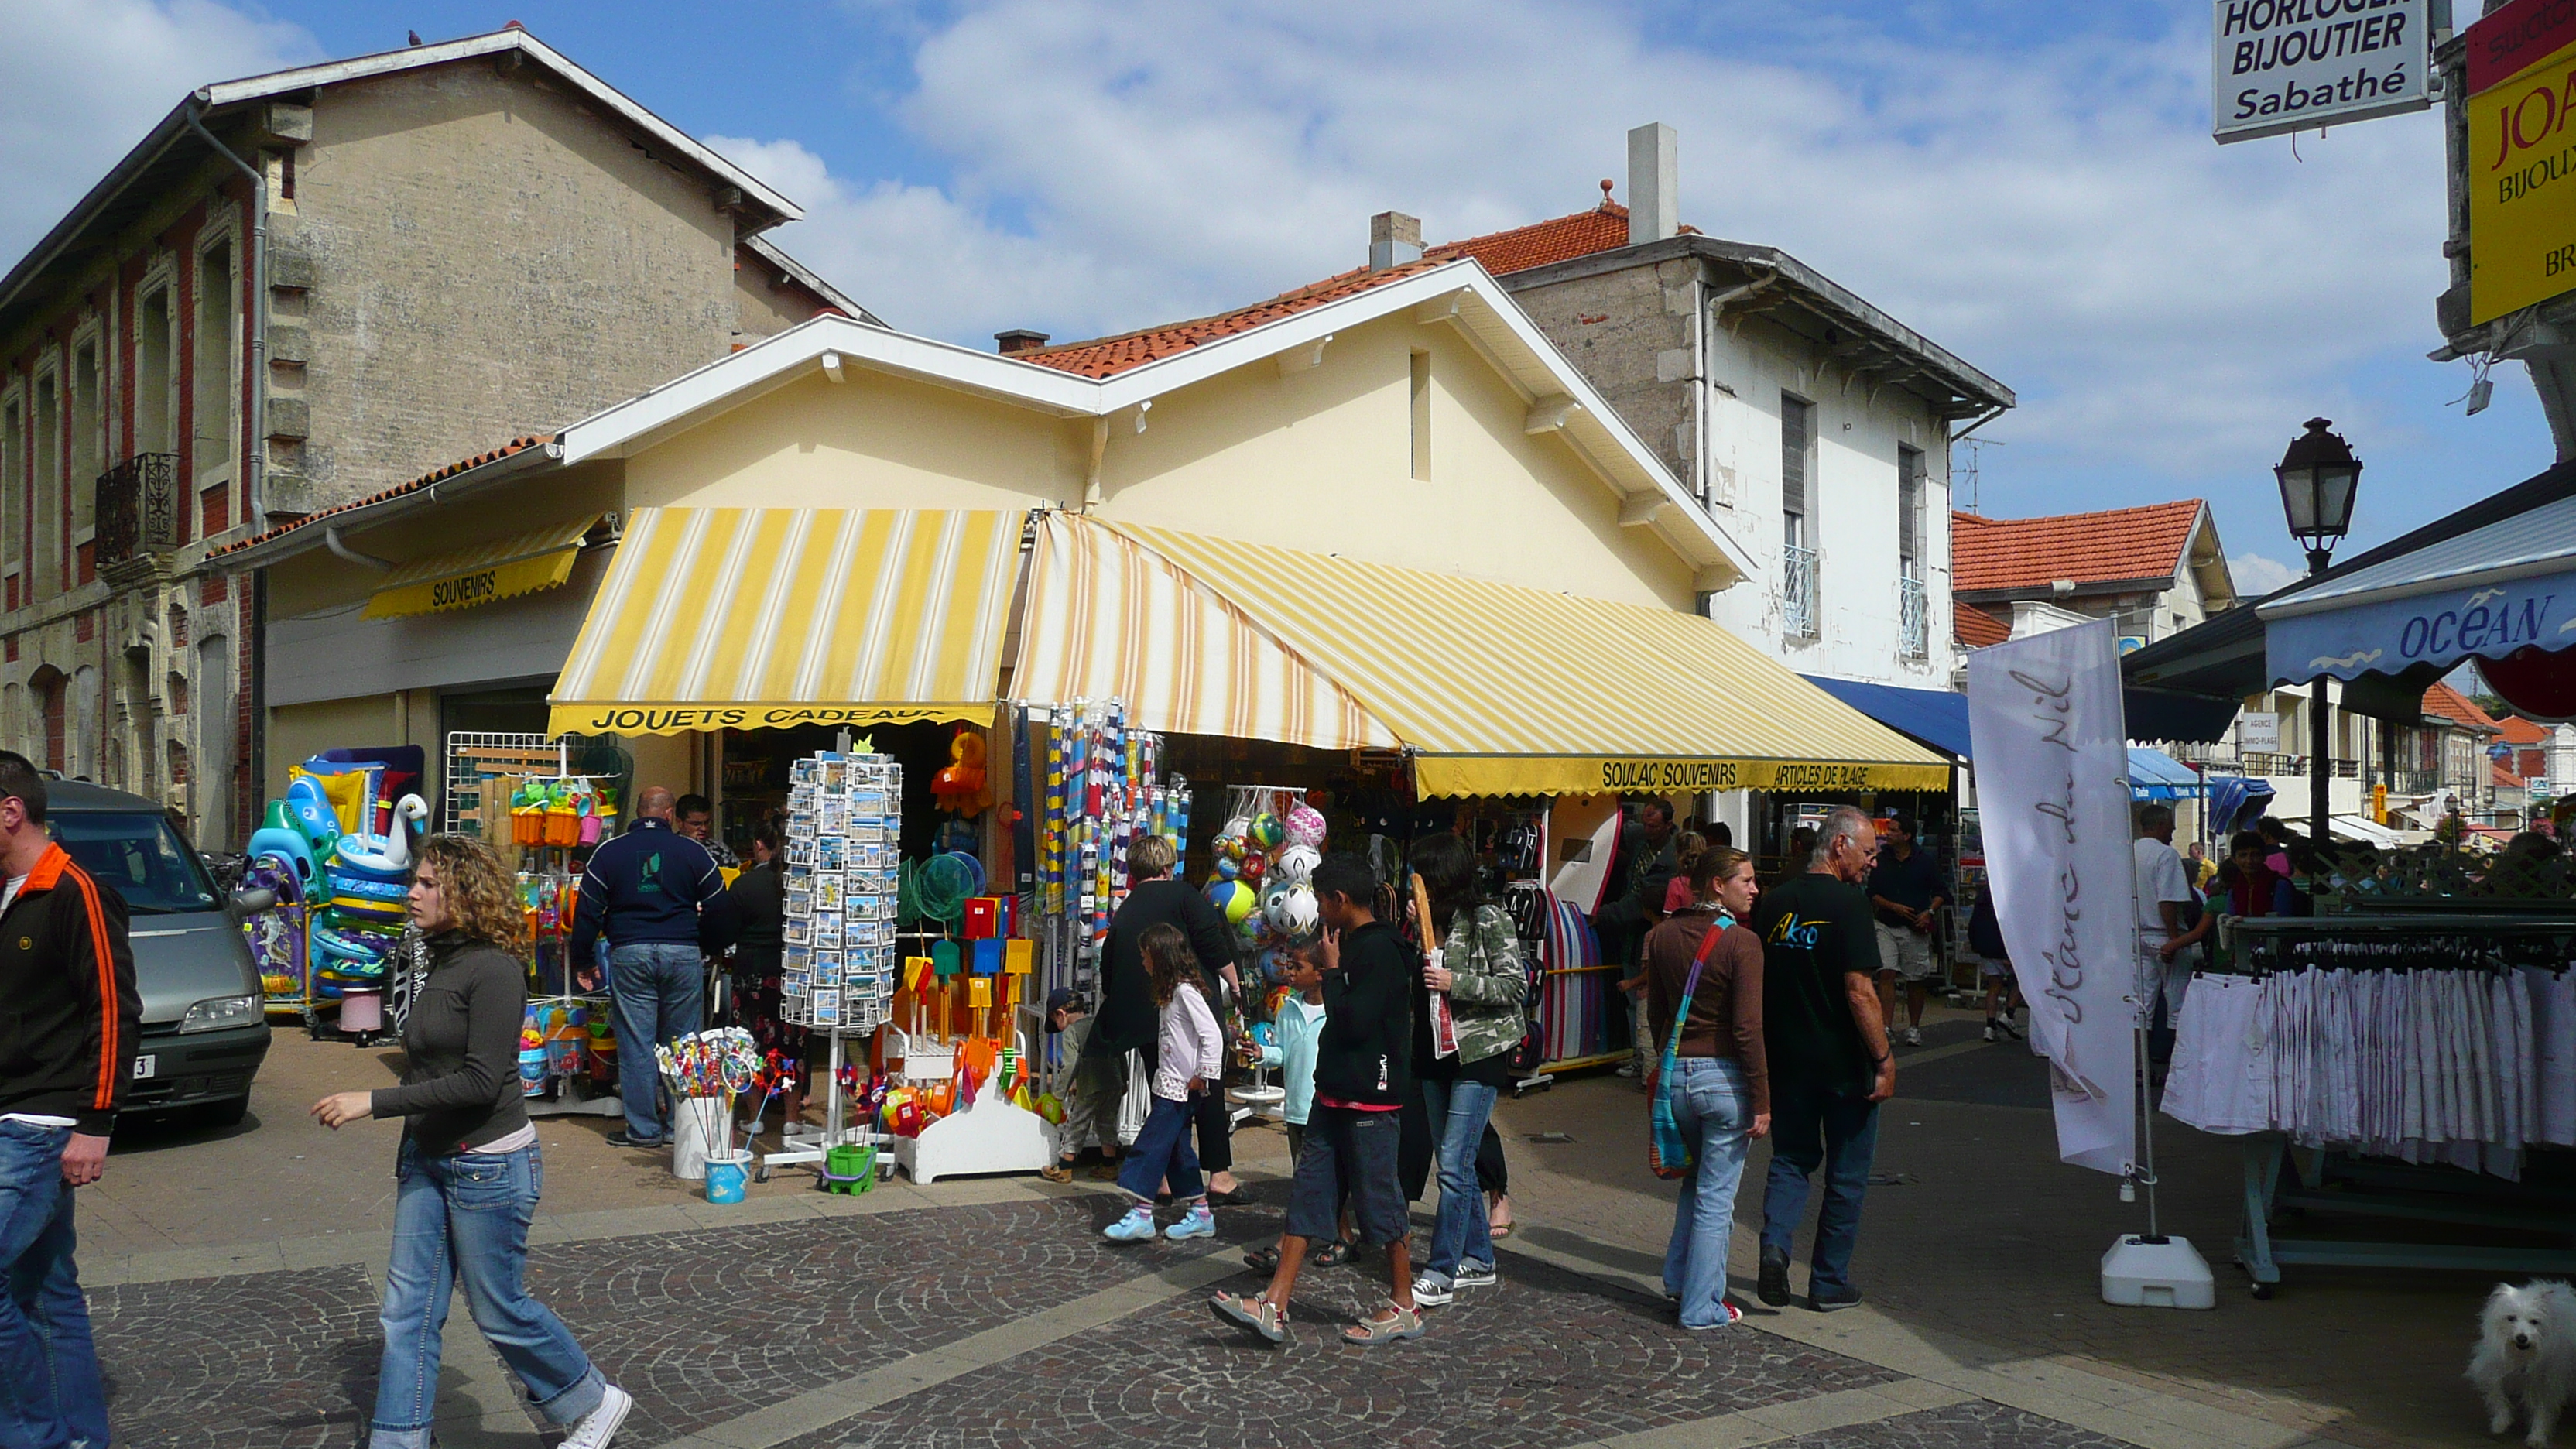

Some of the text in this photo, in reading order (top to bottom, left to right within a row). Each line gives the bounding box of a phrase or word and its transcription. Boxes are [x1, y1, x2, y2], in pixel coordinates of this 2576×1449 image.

[2223, 0, 2410, 36] HORLO
[2489, 0, 2576, 63] swatc
[2232, 12, 2406, 75] BIJOUTIER
[2234, 63, 2406, 119] Sabathé
[433, 570, 495, 607] SOUVENIRS
[592, 708, 748, 730] JOUETS
[2009, 670, 2079, 753] Nil
[1602, 762, 1869, 787] SOULAC SOUVENIRS ARTICLES DE PLAGE
